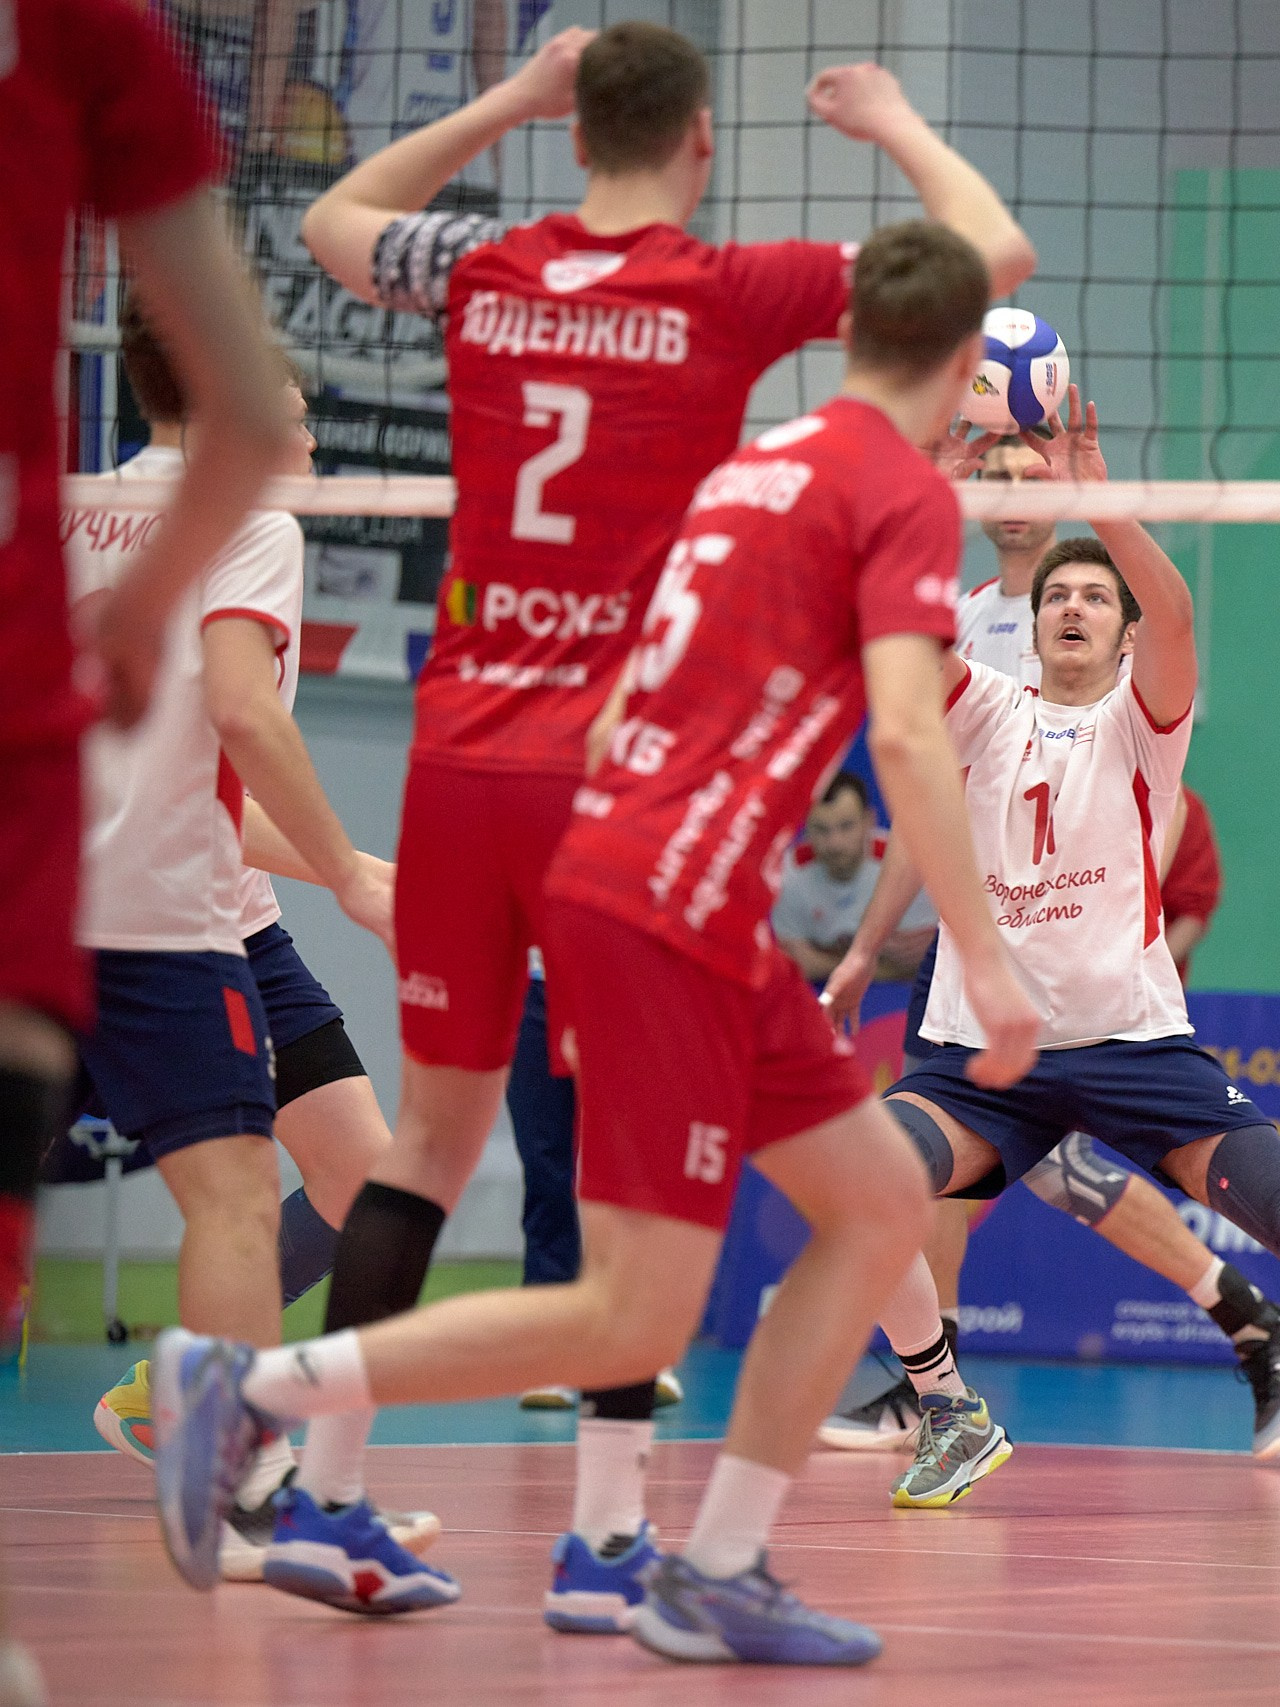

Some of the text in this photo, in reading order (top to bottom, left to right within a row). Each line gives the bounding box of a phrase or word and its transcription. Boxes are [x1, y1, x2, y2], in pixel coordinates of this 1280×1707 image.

[460, 290, 689, 364] ЮДЕНКОВ
[512, 380, 593, 545] 2
[685, 1120, 729, 1184] 15
